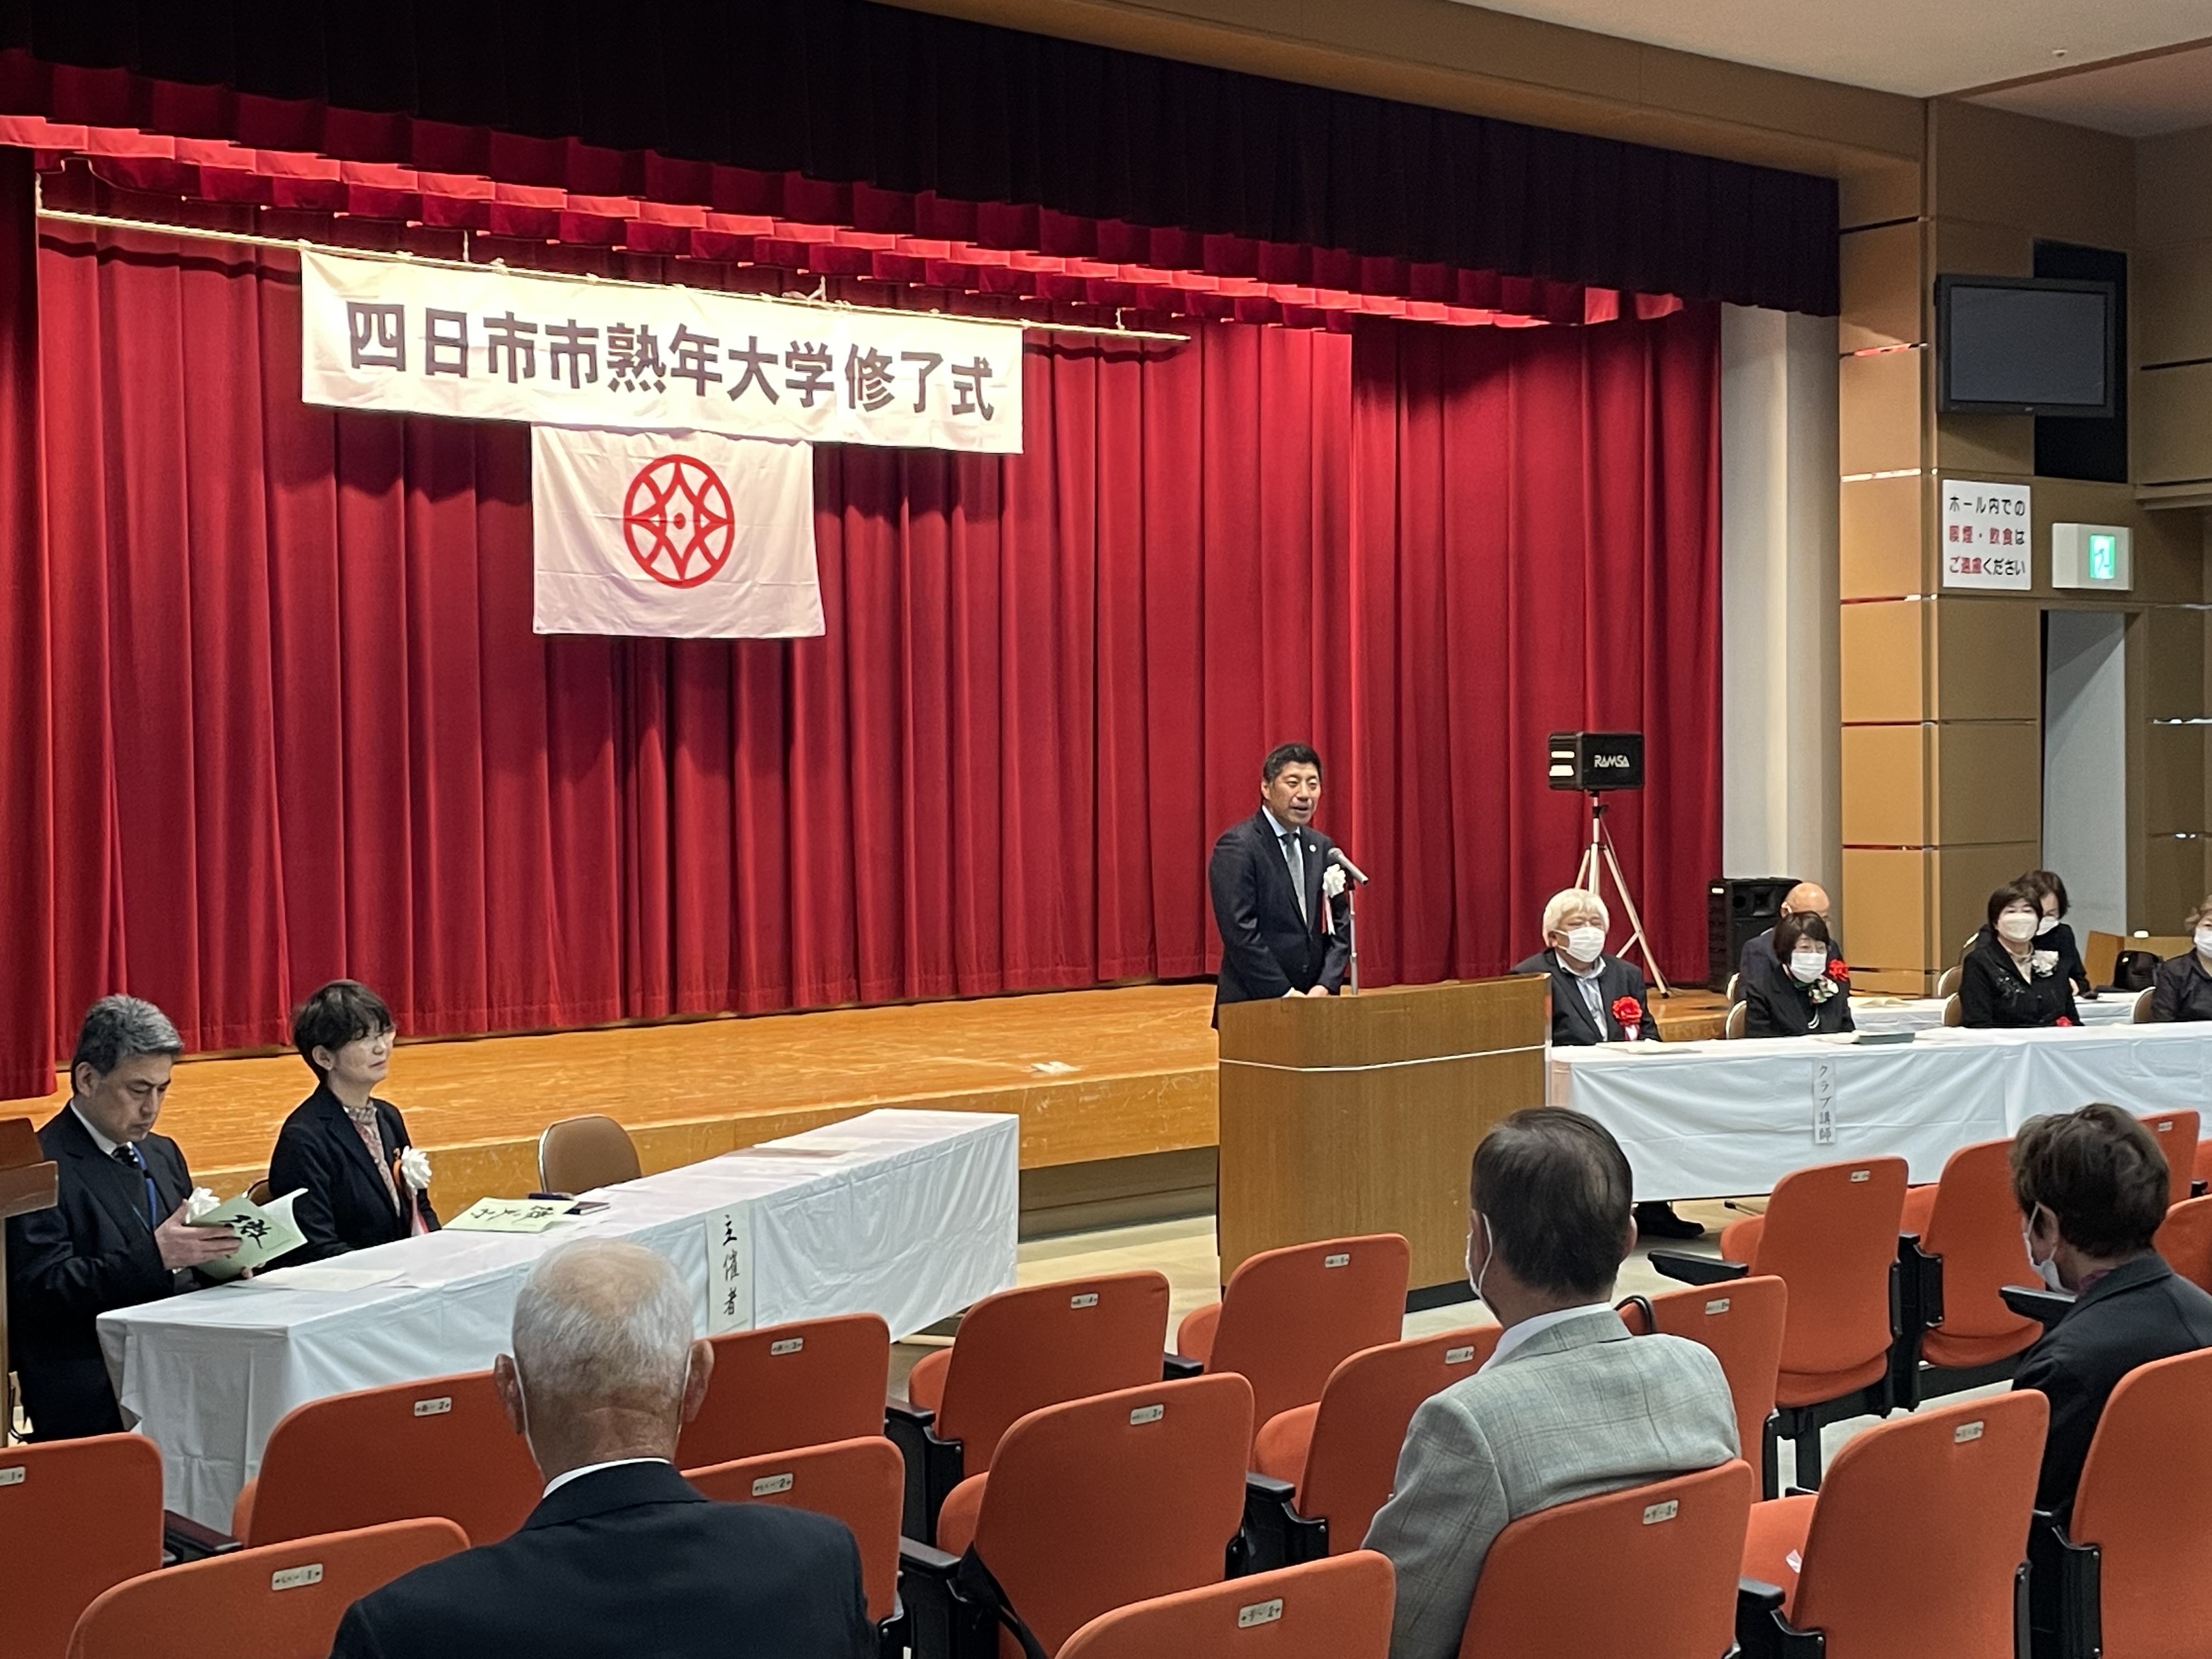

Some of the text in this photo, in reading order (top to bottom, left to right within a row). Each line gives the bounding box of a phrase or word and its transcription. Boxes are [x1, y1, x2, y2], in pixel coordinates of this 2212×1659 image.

[347, 301, 994, 421] 四日市市熟年大学修了式
[1949, 496, 2025, 516] ホール内での
[1949, 526, 2025, 545] 喫煙・飲食は
[1949, 556, 2026, 575] ご遠慮ください
[1594, 754, 1630, 768] RAMSA
[723, 1214, 740, 1316] 主催者
